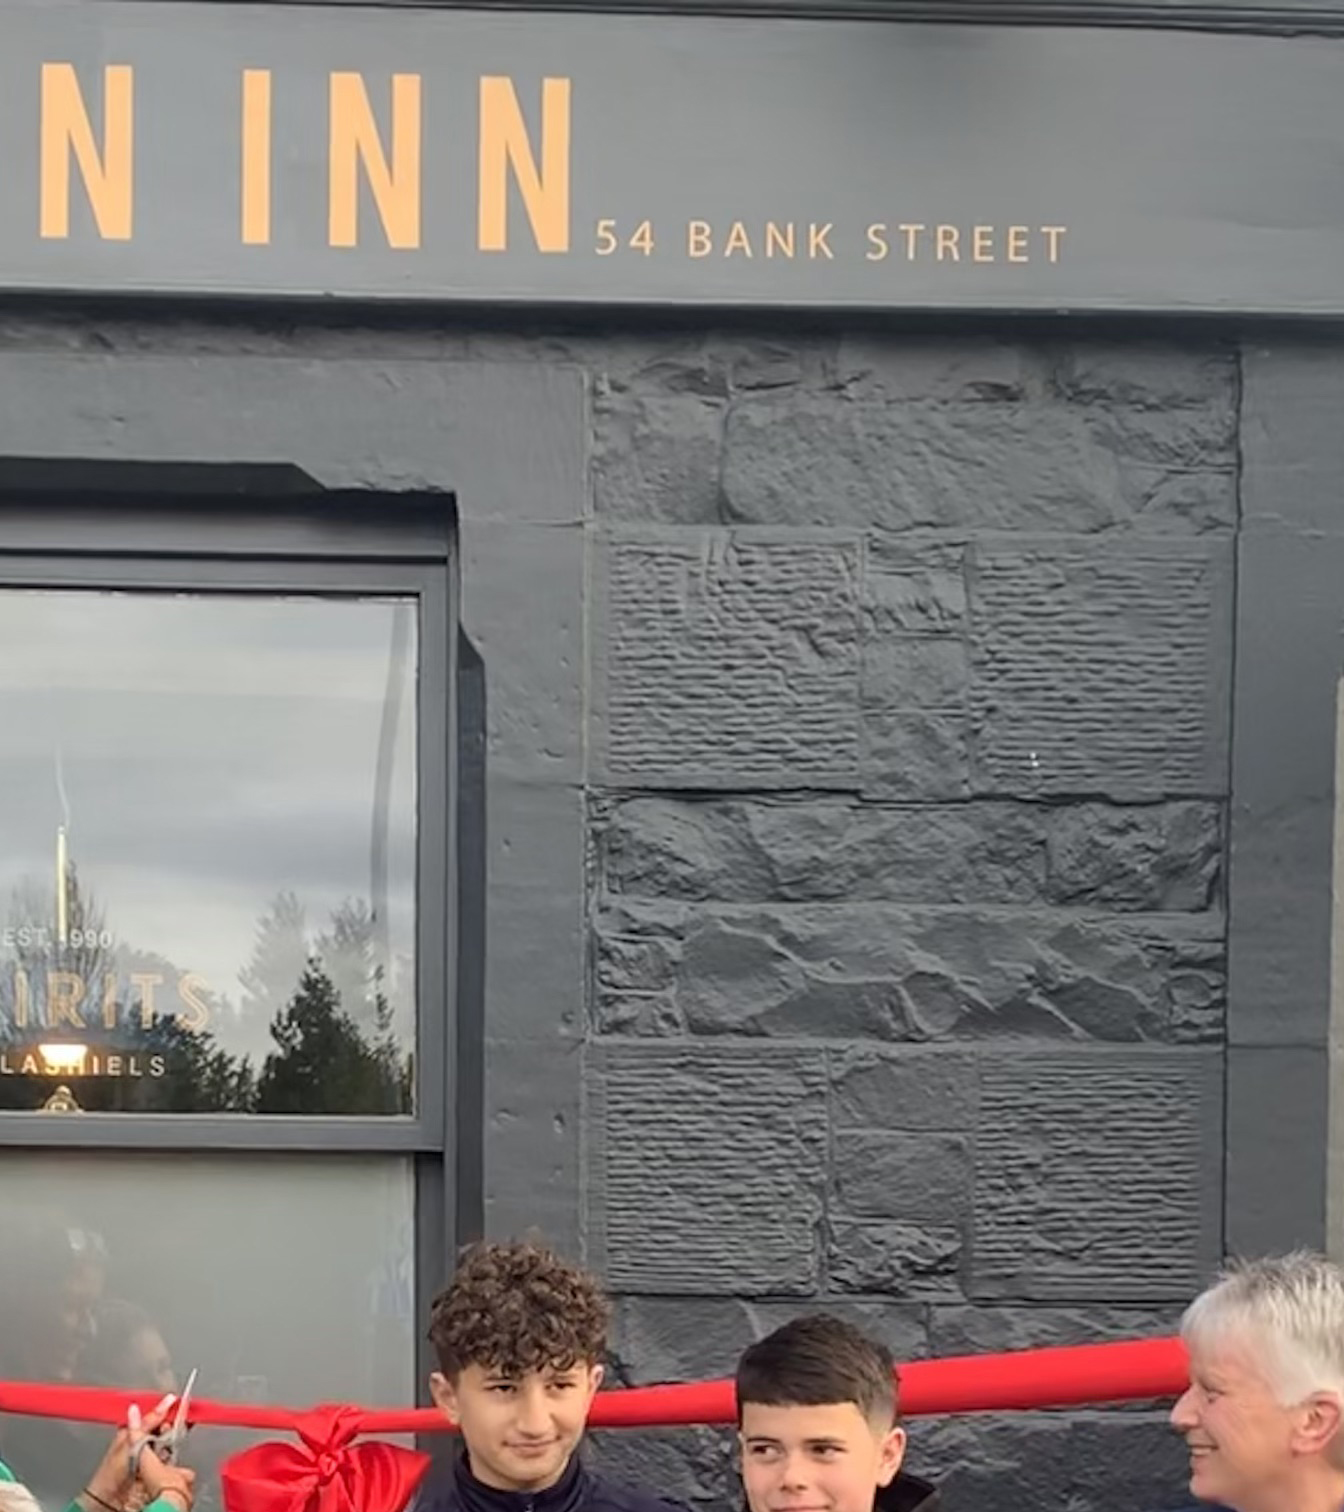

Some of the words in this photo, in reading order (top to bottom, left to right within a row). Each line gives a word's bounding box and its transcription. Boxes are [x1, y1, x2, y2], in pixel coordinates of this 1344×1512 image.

[241, 69, 571, 253] INN
[596, 219, 655, 255] 54
[687, 221, 834, 259] BANK
[867, 223, 1068, 263] STREET
[2, 926, 52, 947] EST.
